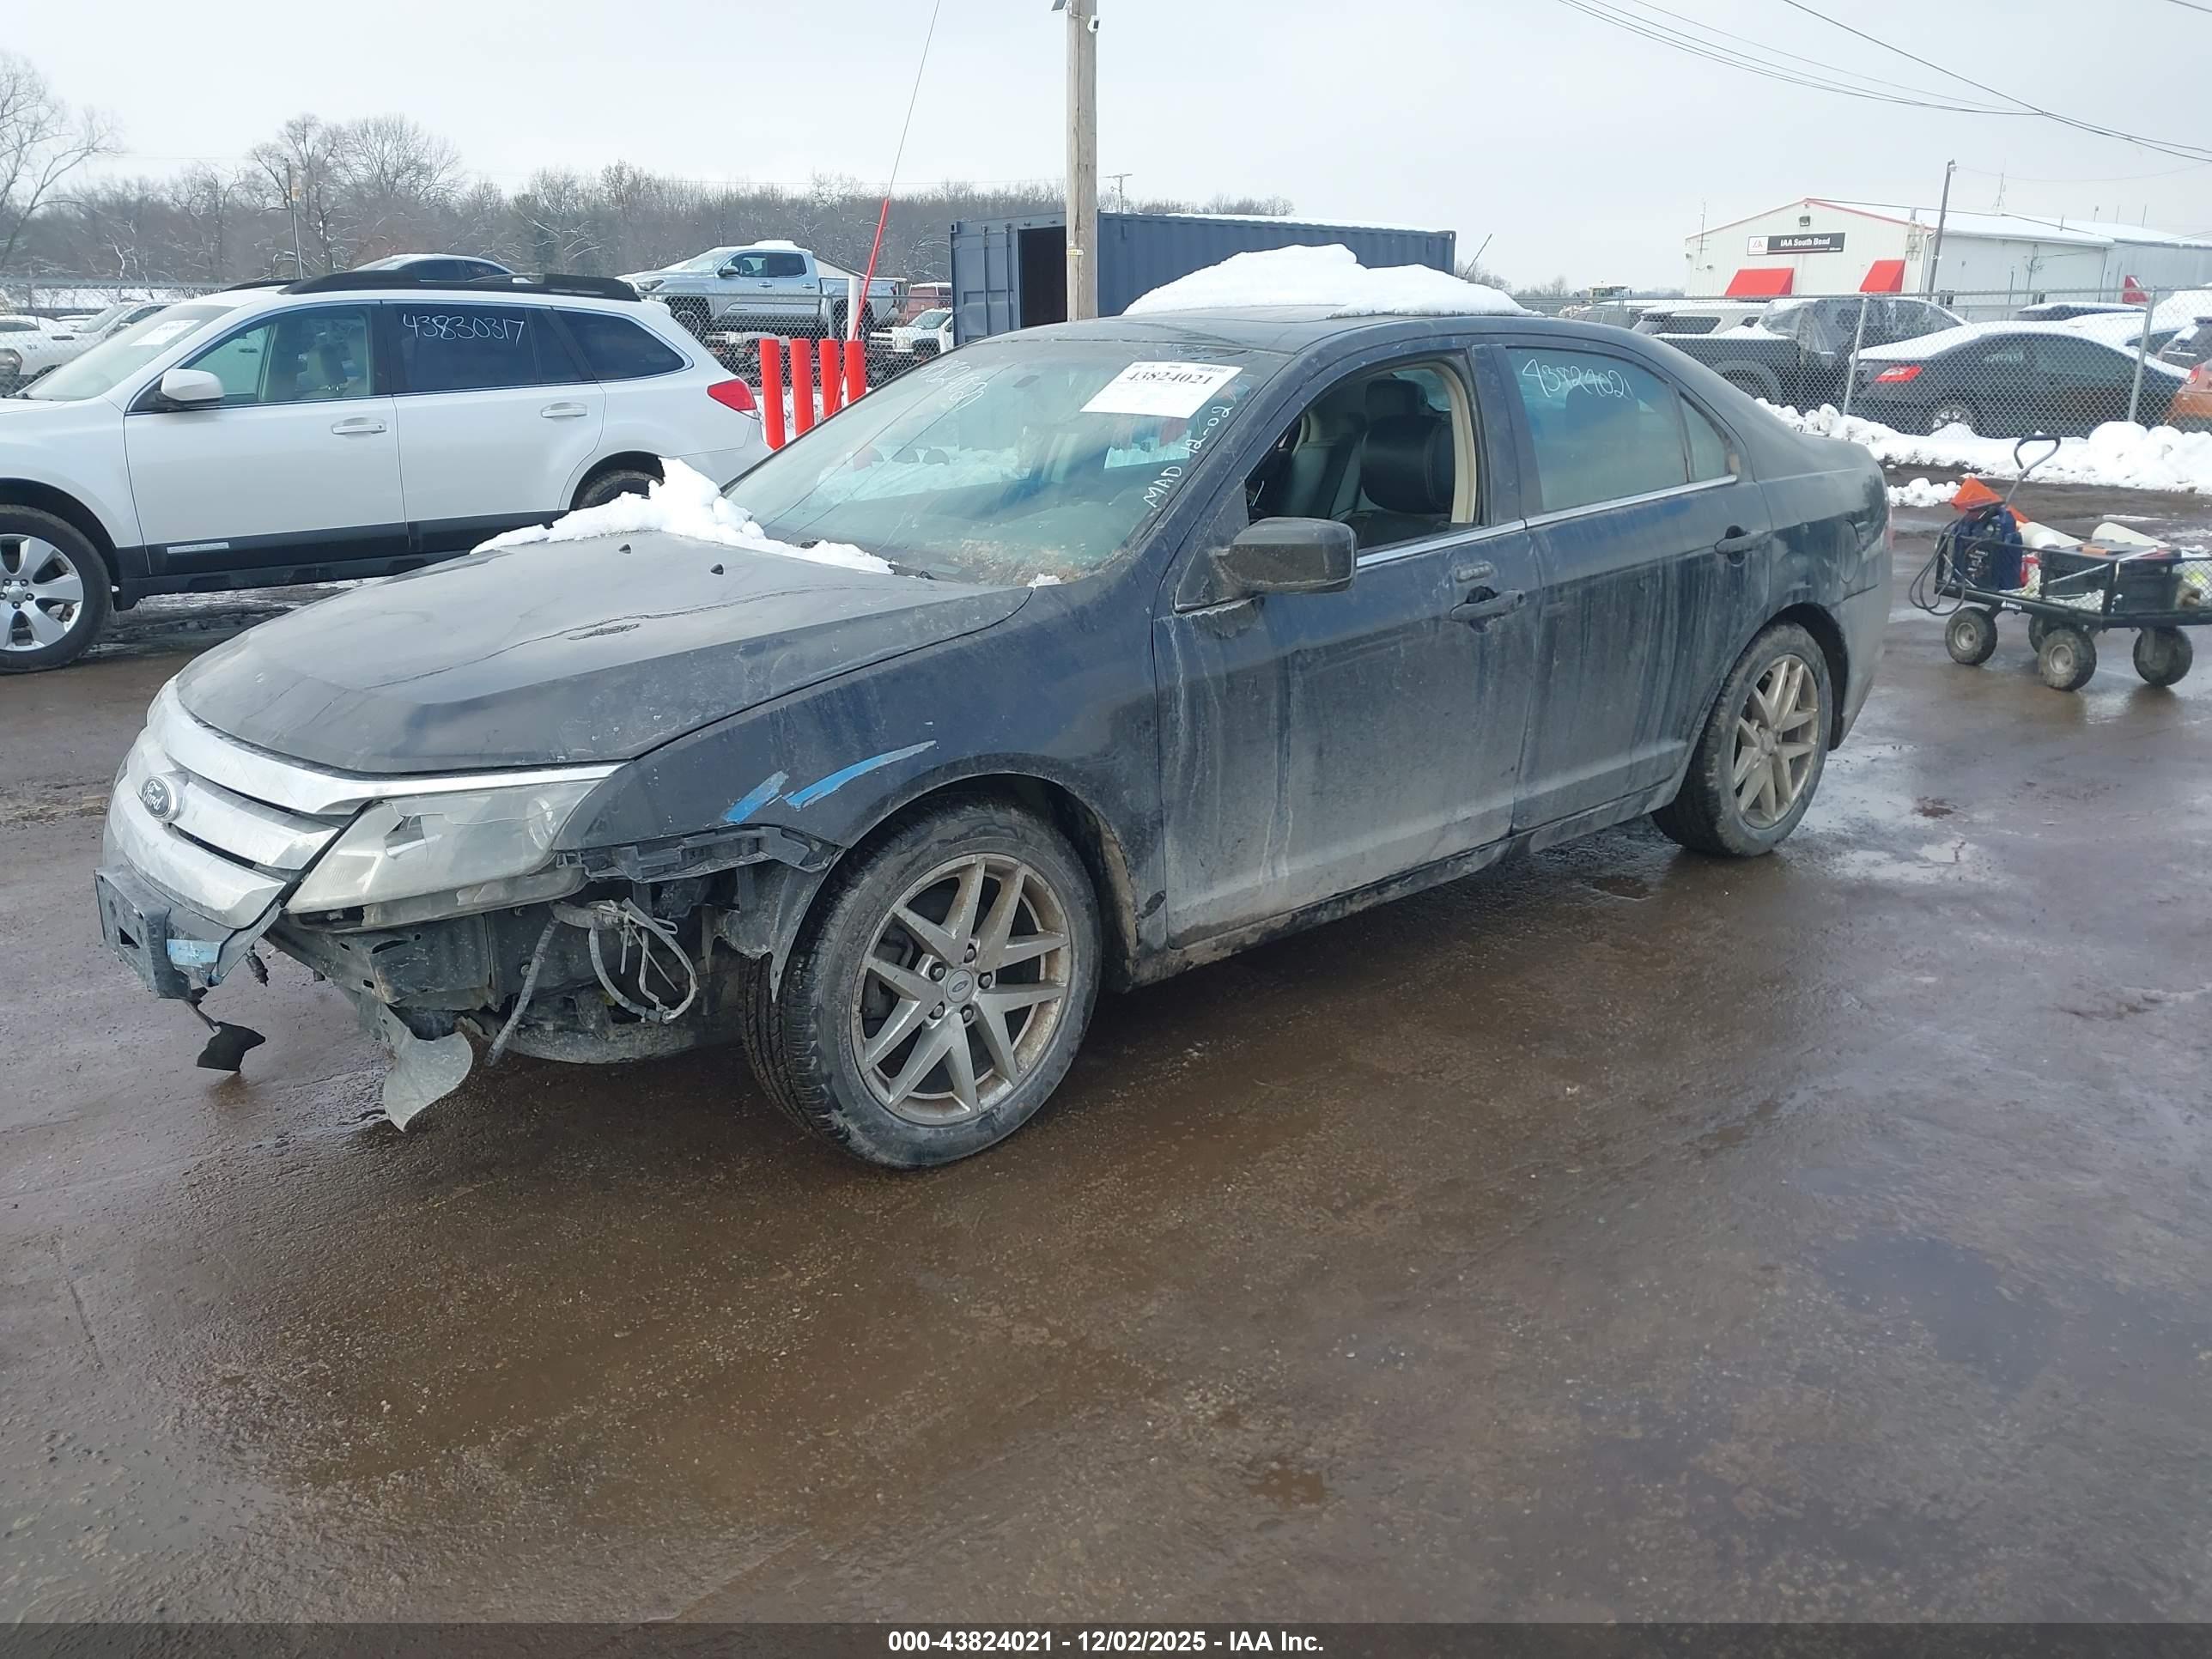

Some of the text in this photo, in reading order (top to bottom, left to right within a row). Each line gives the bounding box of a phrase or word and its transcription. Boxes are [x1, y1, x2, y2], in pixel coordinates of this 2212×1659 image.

[1793, 238, 1812, 246] South
[403, 313, 525, 346] 43830317
[1127, 371, 1214, 385] 43824021
[1143, 466, 1182, 507] MAD
[143, 781, 164, 811] Ford
